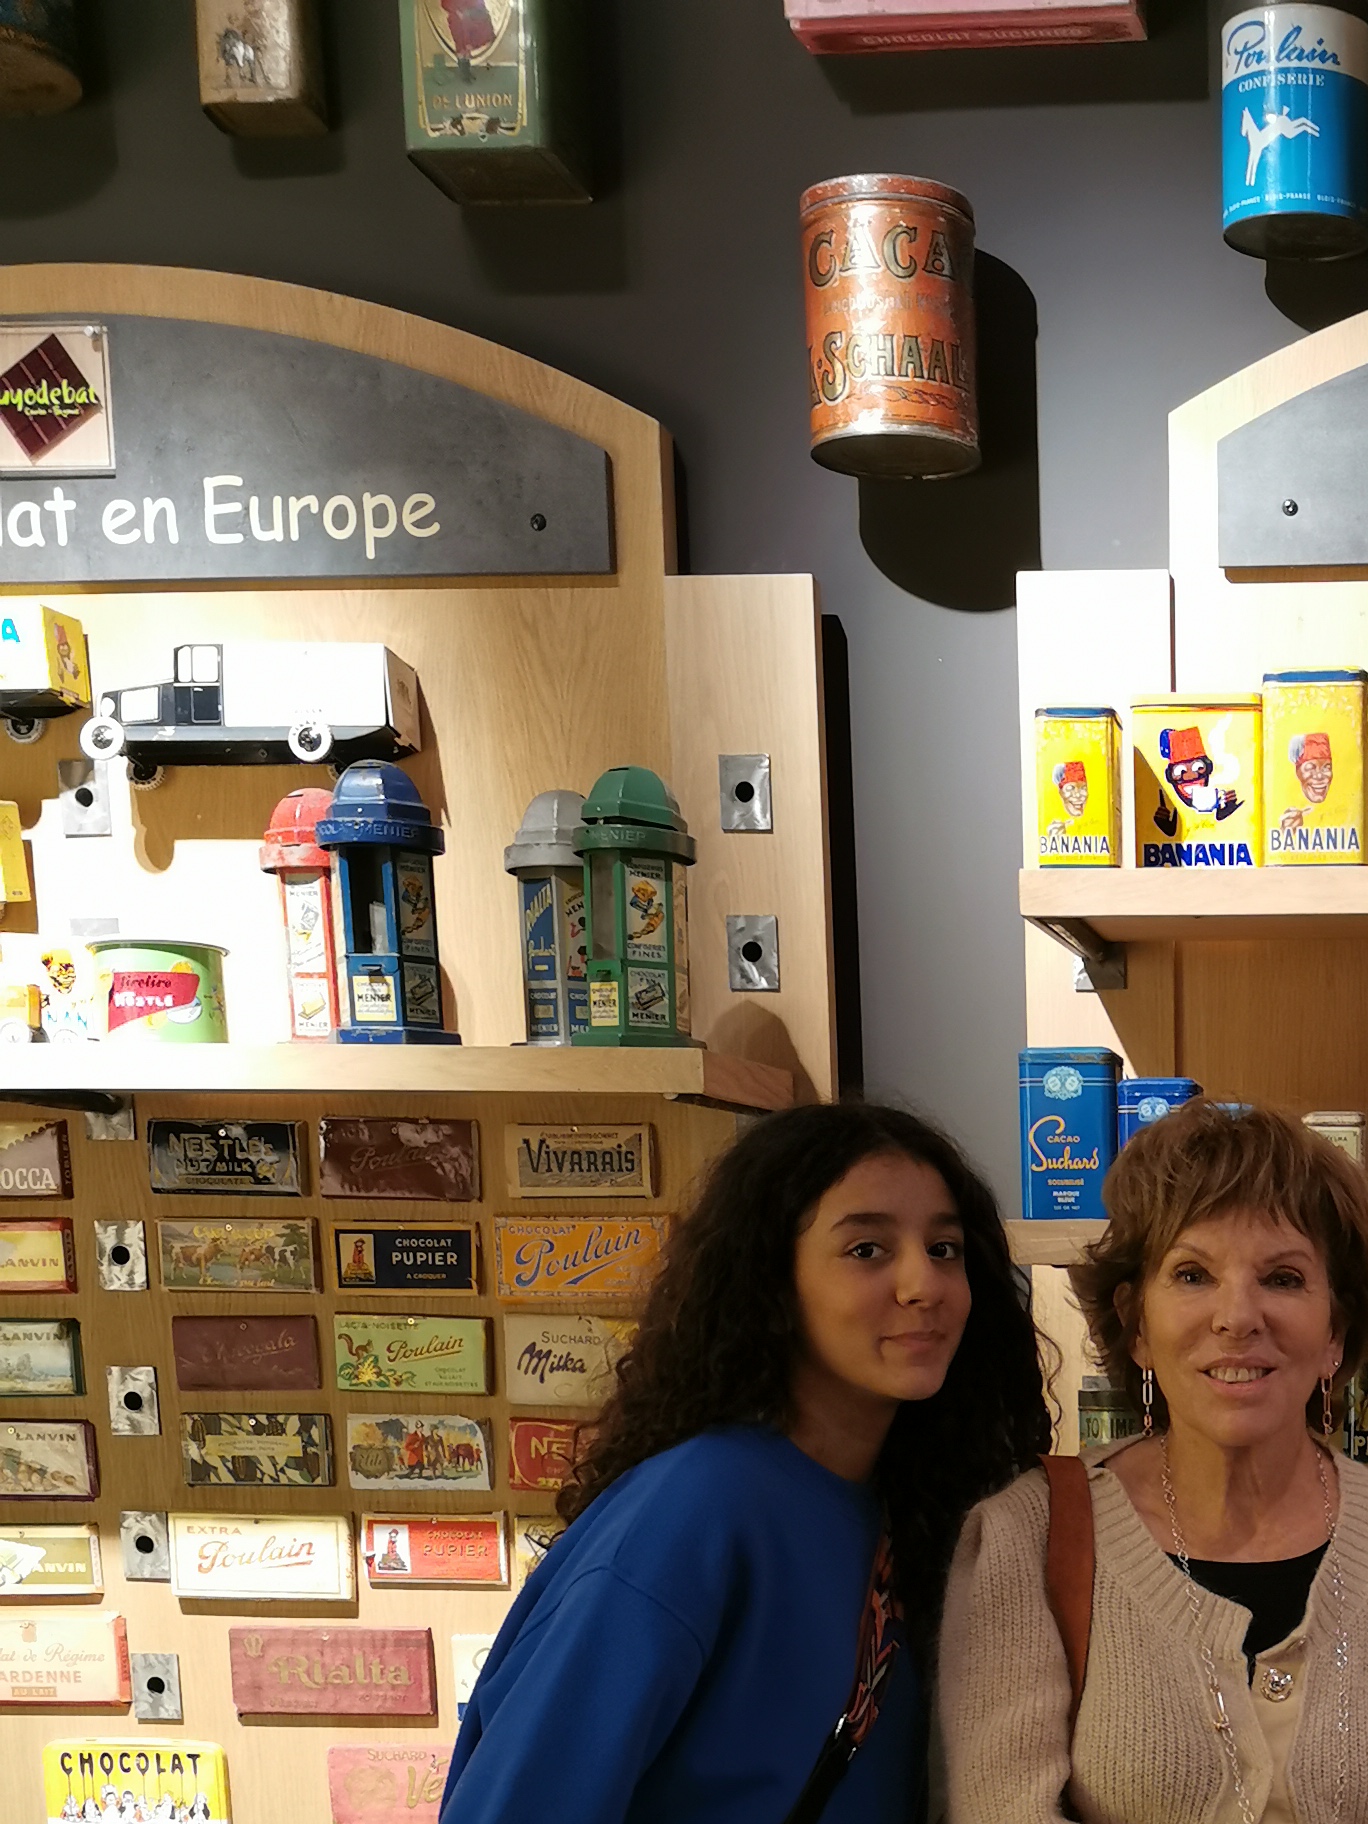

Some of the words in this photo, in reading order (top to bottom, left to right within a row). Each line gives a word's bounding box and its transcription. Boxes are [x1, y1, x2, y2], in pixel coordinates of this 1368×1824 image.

[1227, 20, 1340, 74] Poulain
[1238, 74, 1325, 93] CONFISERIE
[102, 494, 179, 546] en
[202, 476, 441, 560] Europe
[1039, 836, 1110, 855] BANANIA
[1269, 827, 1360, 851] BANANIA
[1143, 843, 1254, 867] BANANIA
[632, 1012, 667, 1021] MENIER
[1028, 1115, 1099, 1172] Suchard
[1046, 1135, 1080, 1144] CACAO
[508, 1225, 572, 1235] CHOCOLAT
[395, 1237, 453, 1248] CHOCOLAT
[391, 1252, 459, 1267] PUPIER
[514, 1225, 640, 1287] Poulain
[541, 1331, 601, 1345] SUCHARD
[386, 1334, 464, 1364] Poulain
[517, 1341, 587, 1384] Milka
[16, 1432, 77, 1443] LANVIN
[186, 1525, 242, 1535] EXTRA
[197, 1535, 315, 1574] Poulain
[423, 1544, 490, 1557] PUPIER
[44, 1643, 105, 1667] Régime
[267, 1652, 415, 1690] Rialta
[60, 1752, 202, 1776] CHOCOLAT
[367, 1748, 428, 1762] SUCHARD
